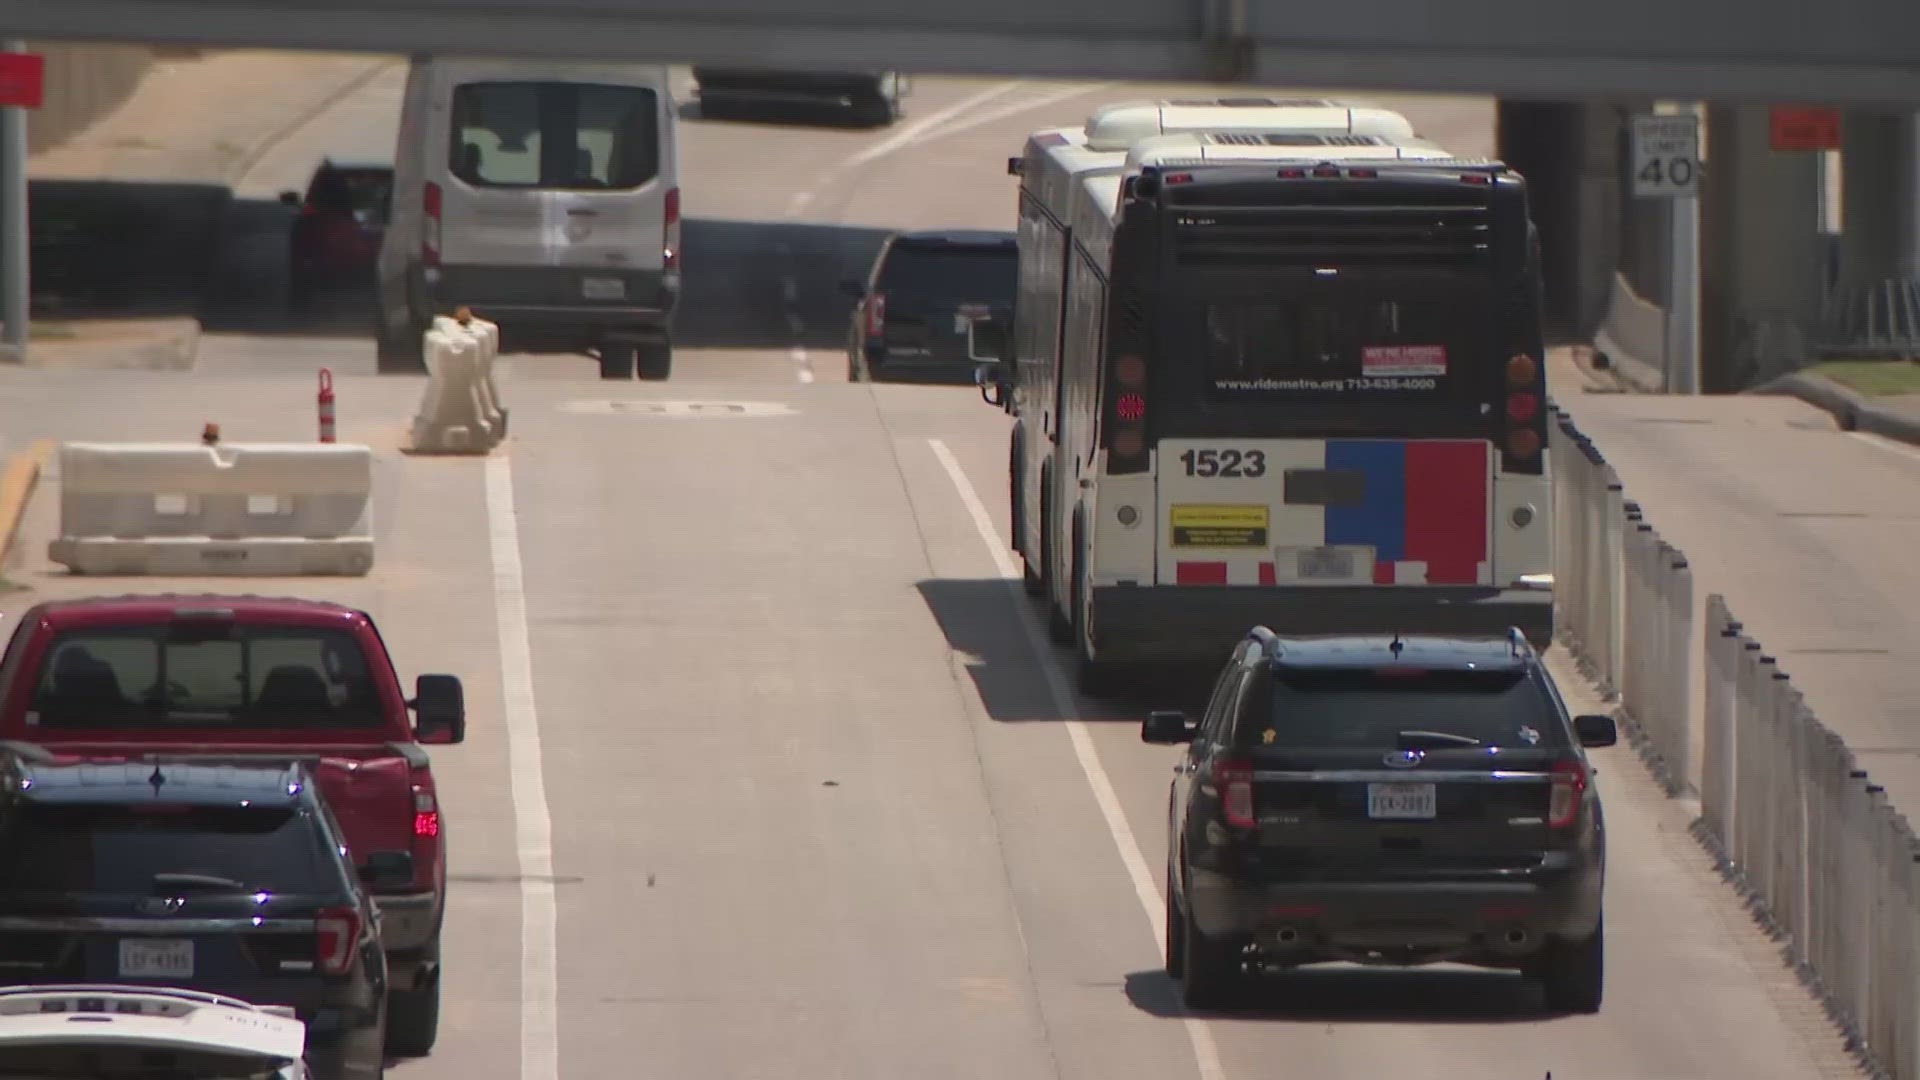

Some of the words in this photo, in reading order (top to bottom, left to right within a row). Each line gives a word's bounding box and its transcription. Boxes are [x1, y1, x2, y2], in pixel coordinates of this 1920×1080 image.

[1643, 140, 1687, 154] LIMIT
[1638, 156, 1692, 187] 40
[1214, 378, 1344, 392] www.ridemetro.org
[1346, 378, 1436, 391] 713-635-4000
[1180, 449, 1266, 477] 1523
